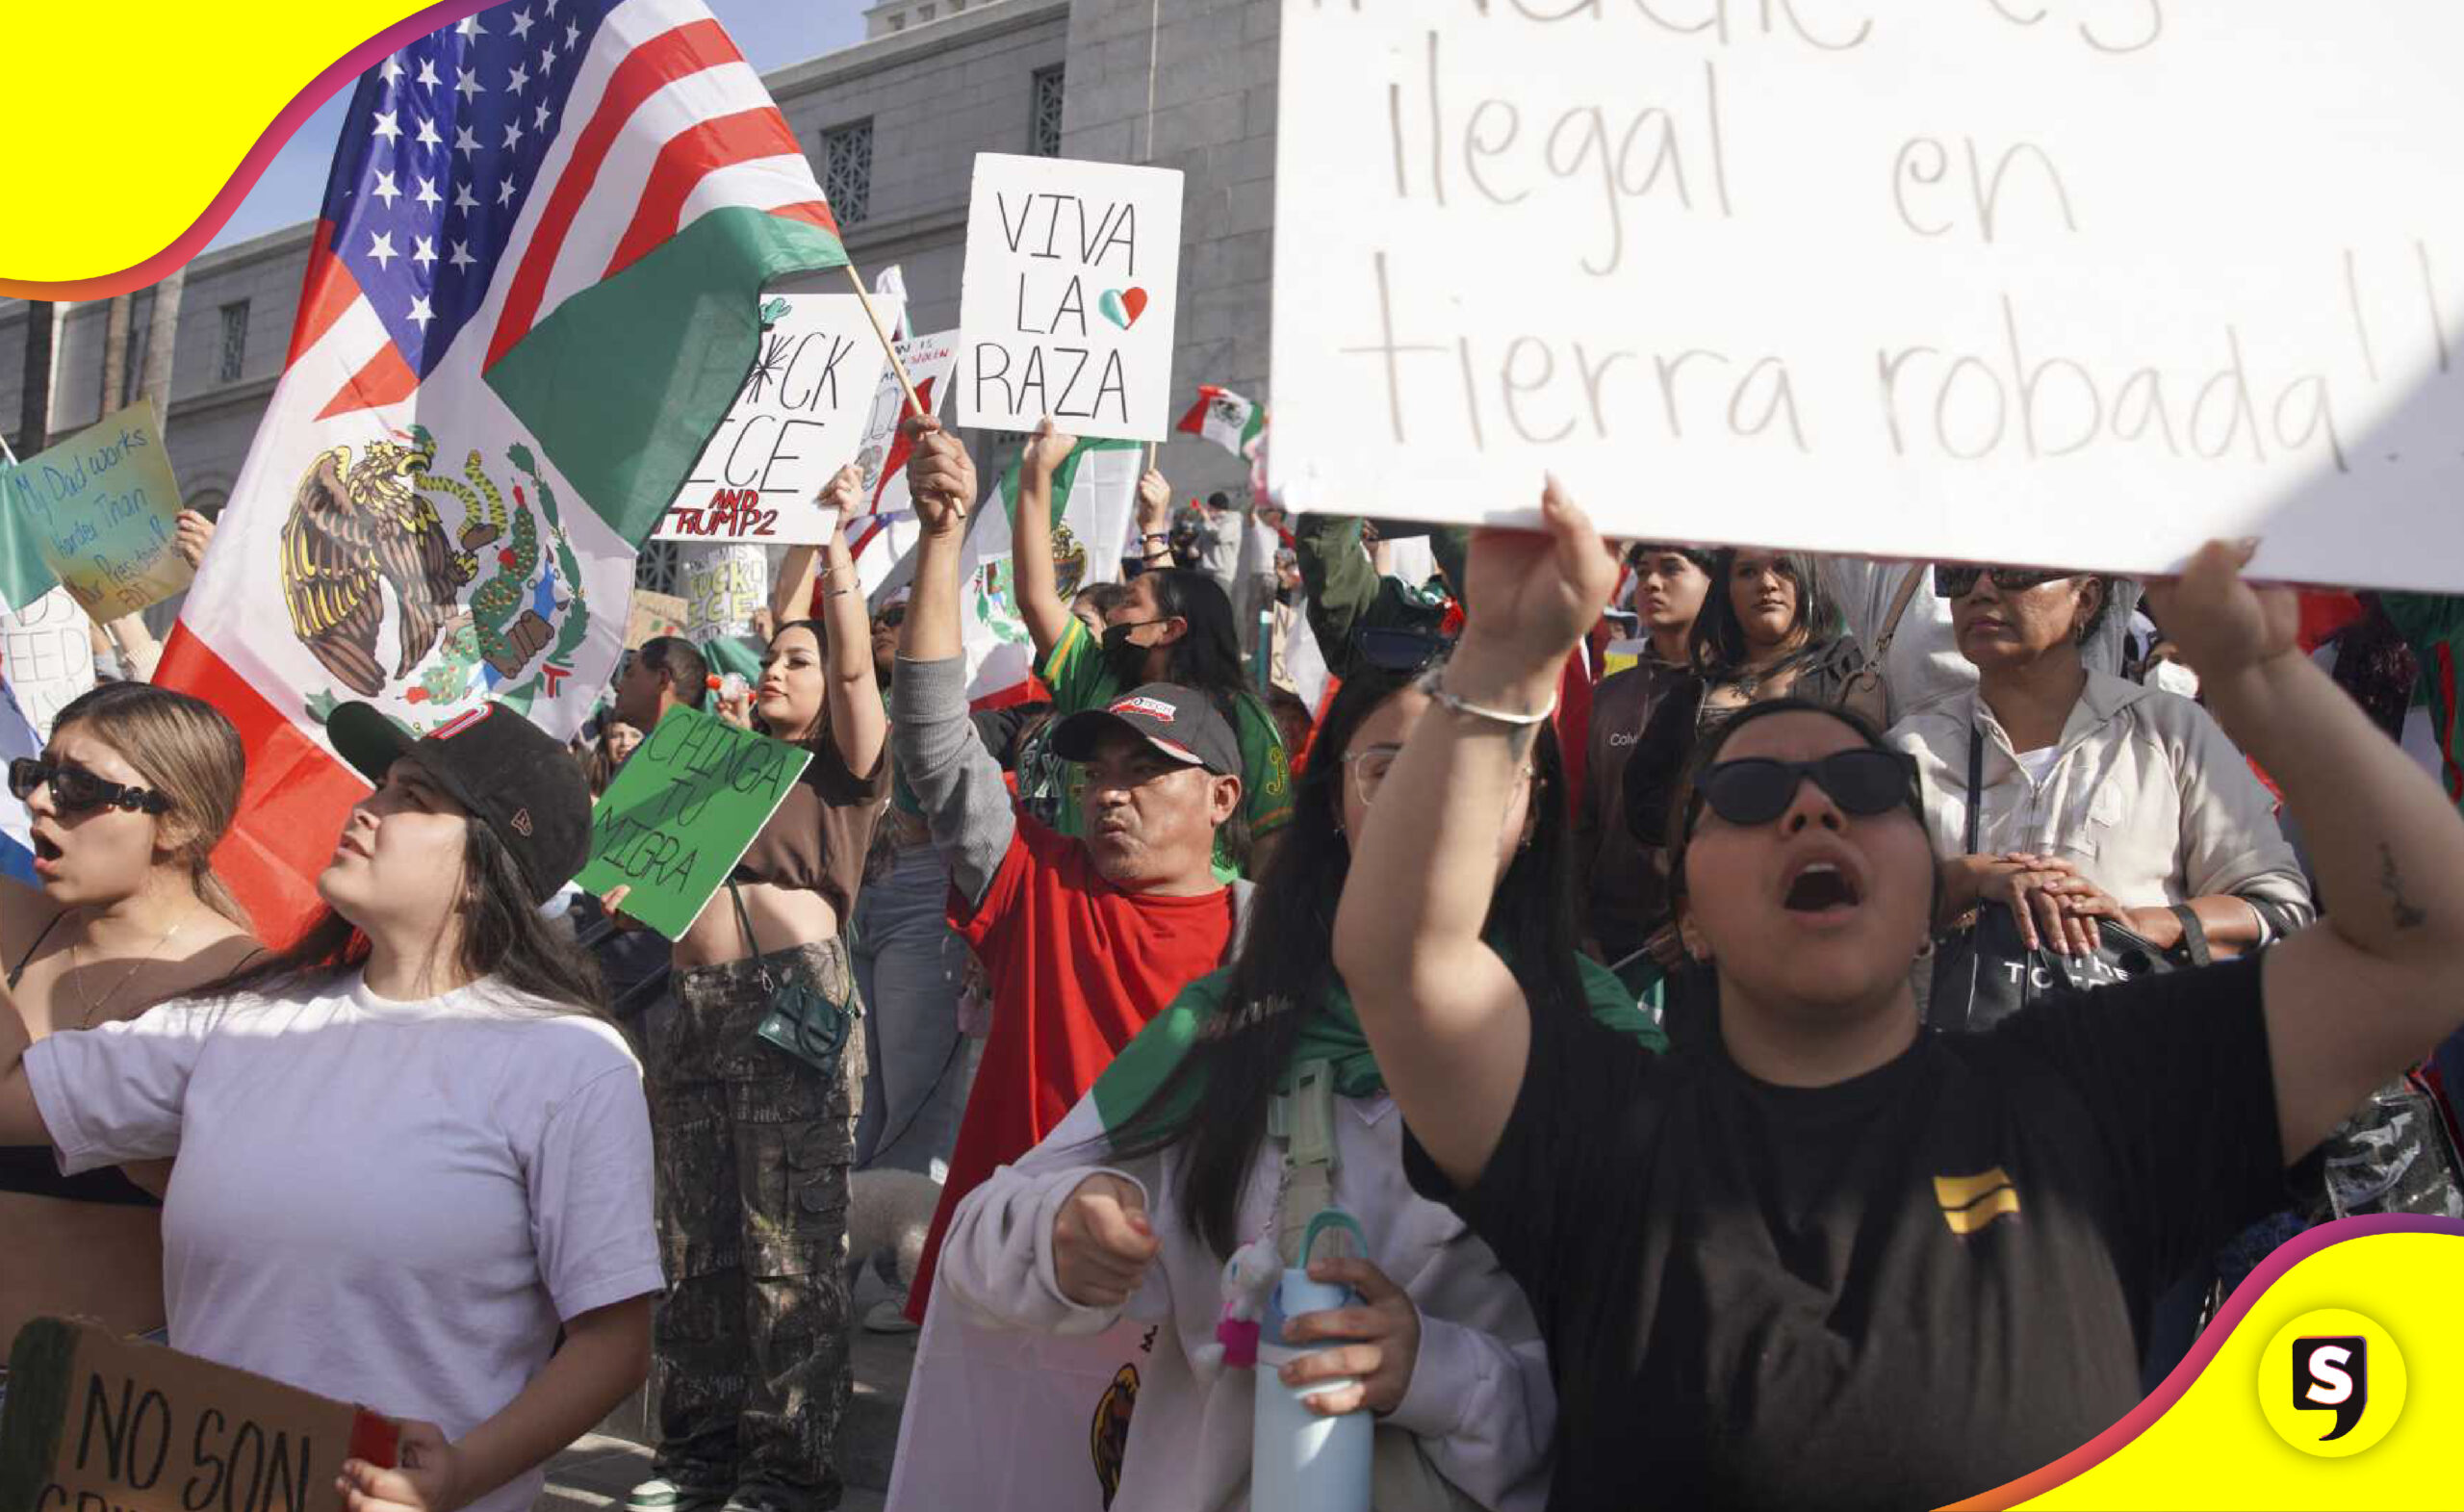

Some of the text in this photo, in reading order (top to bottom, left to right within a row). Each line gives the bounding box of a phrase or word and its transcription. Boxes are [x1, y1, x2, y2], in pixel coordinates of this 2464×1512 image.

[1389, 30, 2077, 277] ilegal en
[997, 192, 1135, 277] VIVA
[1017, 272, 1086, 337] LA
[976, 343, 1128, 423] RAZA
[1341, 250, 1810, 455] tierra
[43, 457, 87, 501] Dad
[708, 488, 759, 511] AND
[648, 713, 786, 800] CHINGA
[658, 777, 714, 828] TU
[593, 807, 698, 894] MIGRA
[76, 1373, 311, 1512] NO SON
